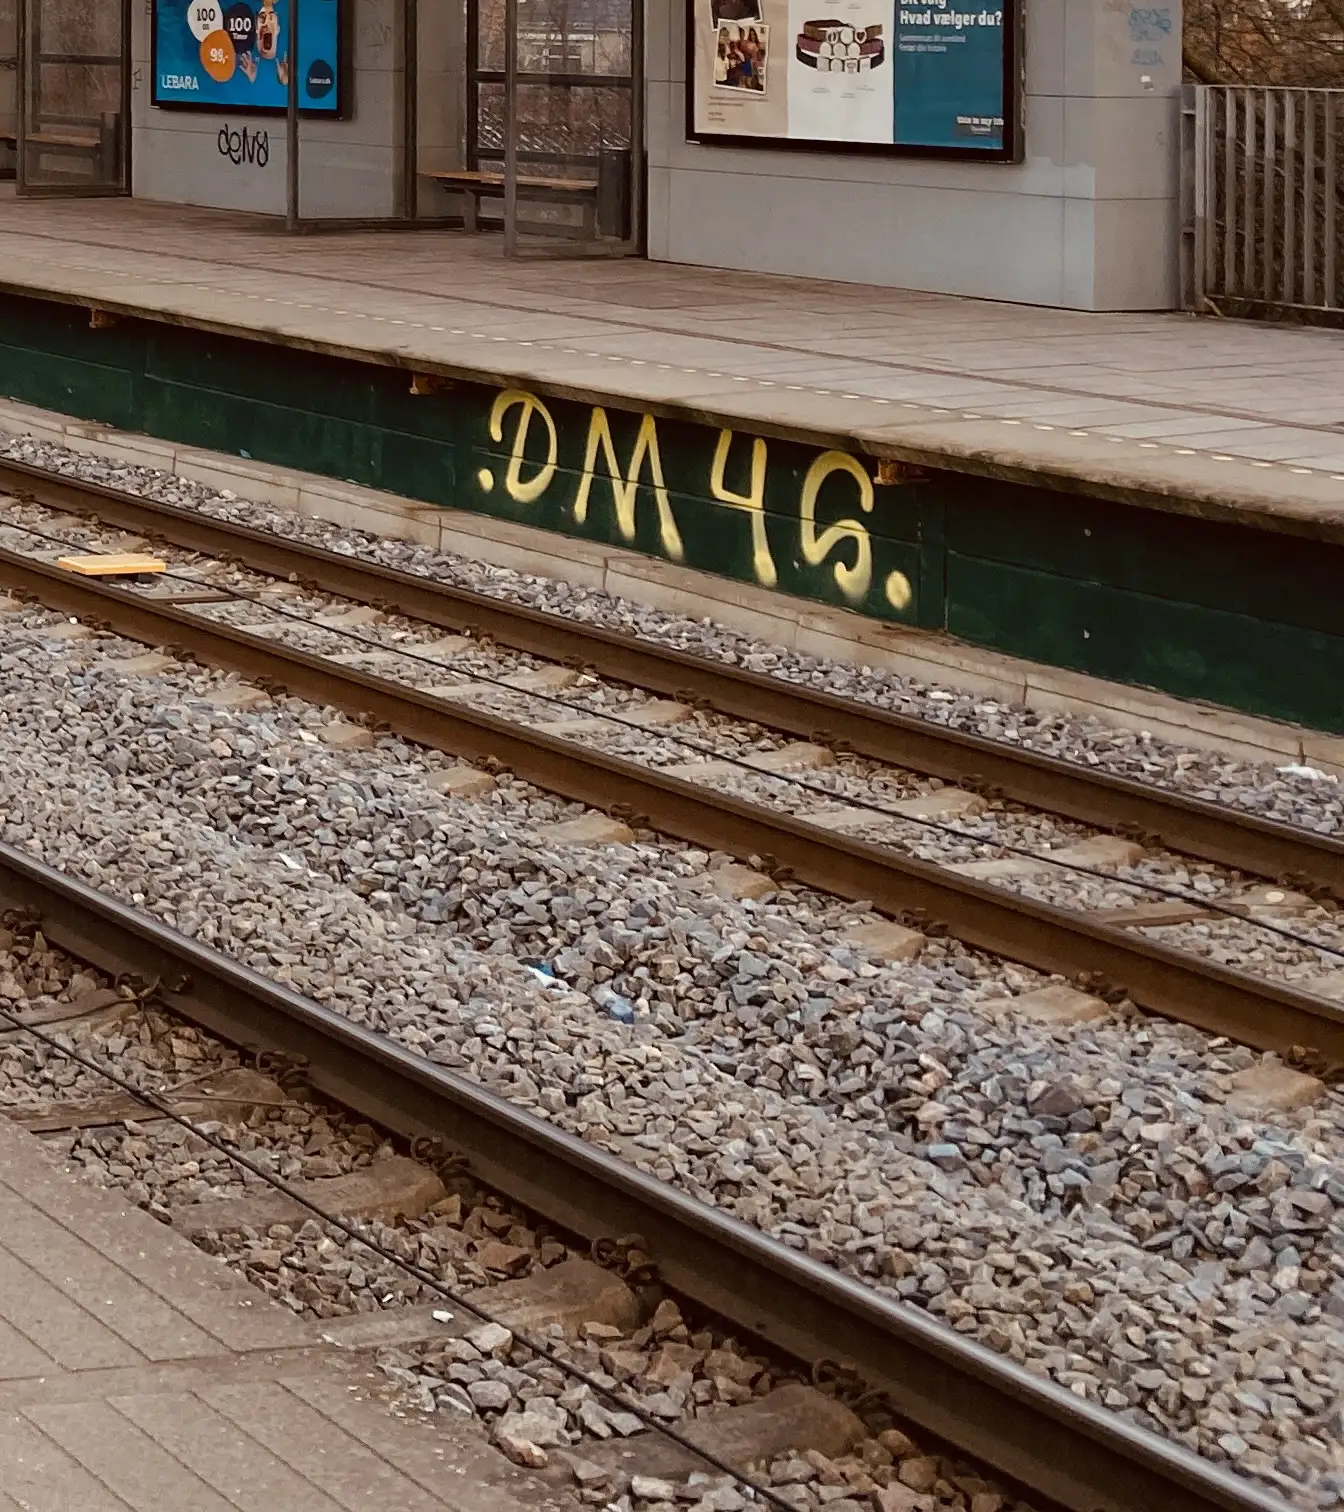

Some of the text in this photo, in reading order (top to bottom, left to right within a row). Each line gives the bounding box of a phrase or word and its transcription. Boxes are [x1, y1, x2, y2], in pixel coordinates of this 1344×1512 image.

[197, 8, 216, 22] 100
[899, 9, 1003, 30] Hvad vælger du?
[229, 17, 252, 32] 100
[161, 74, 200, 90] LEBARA
